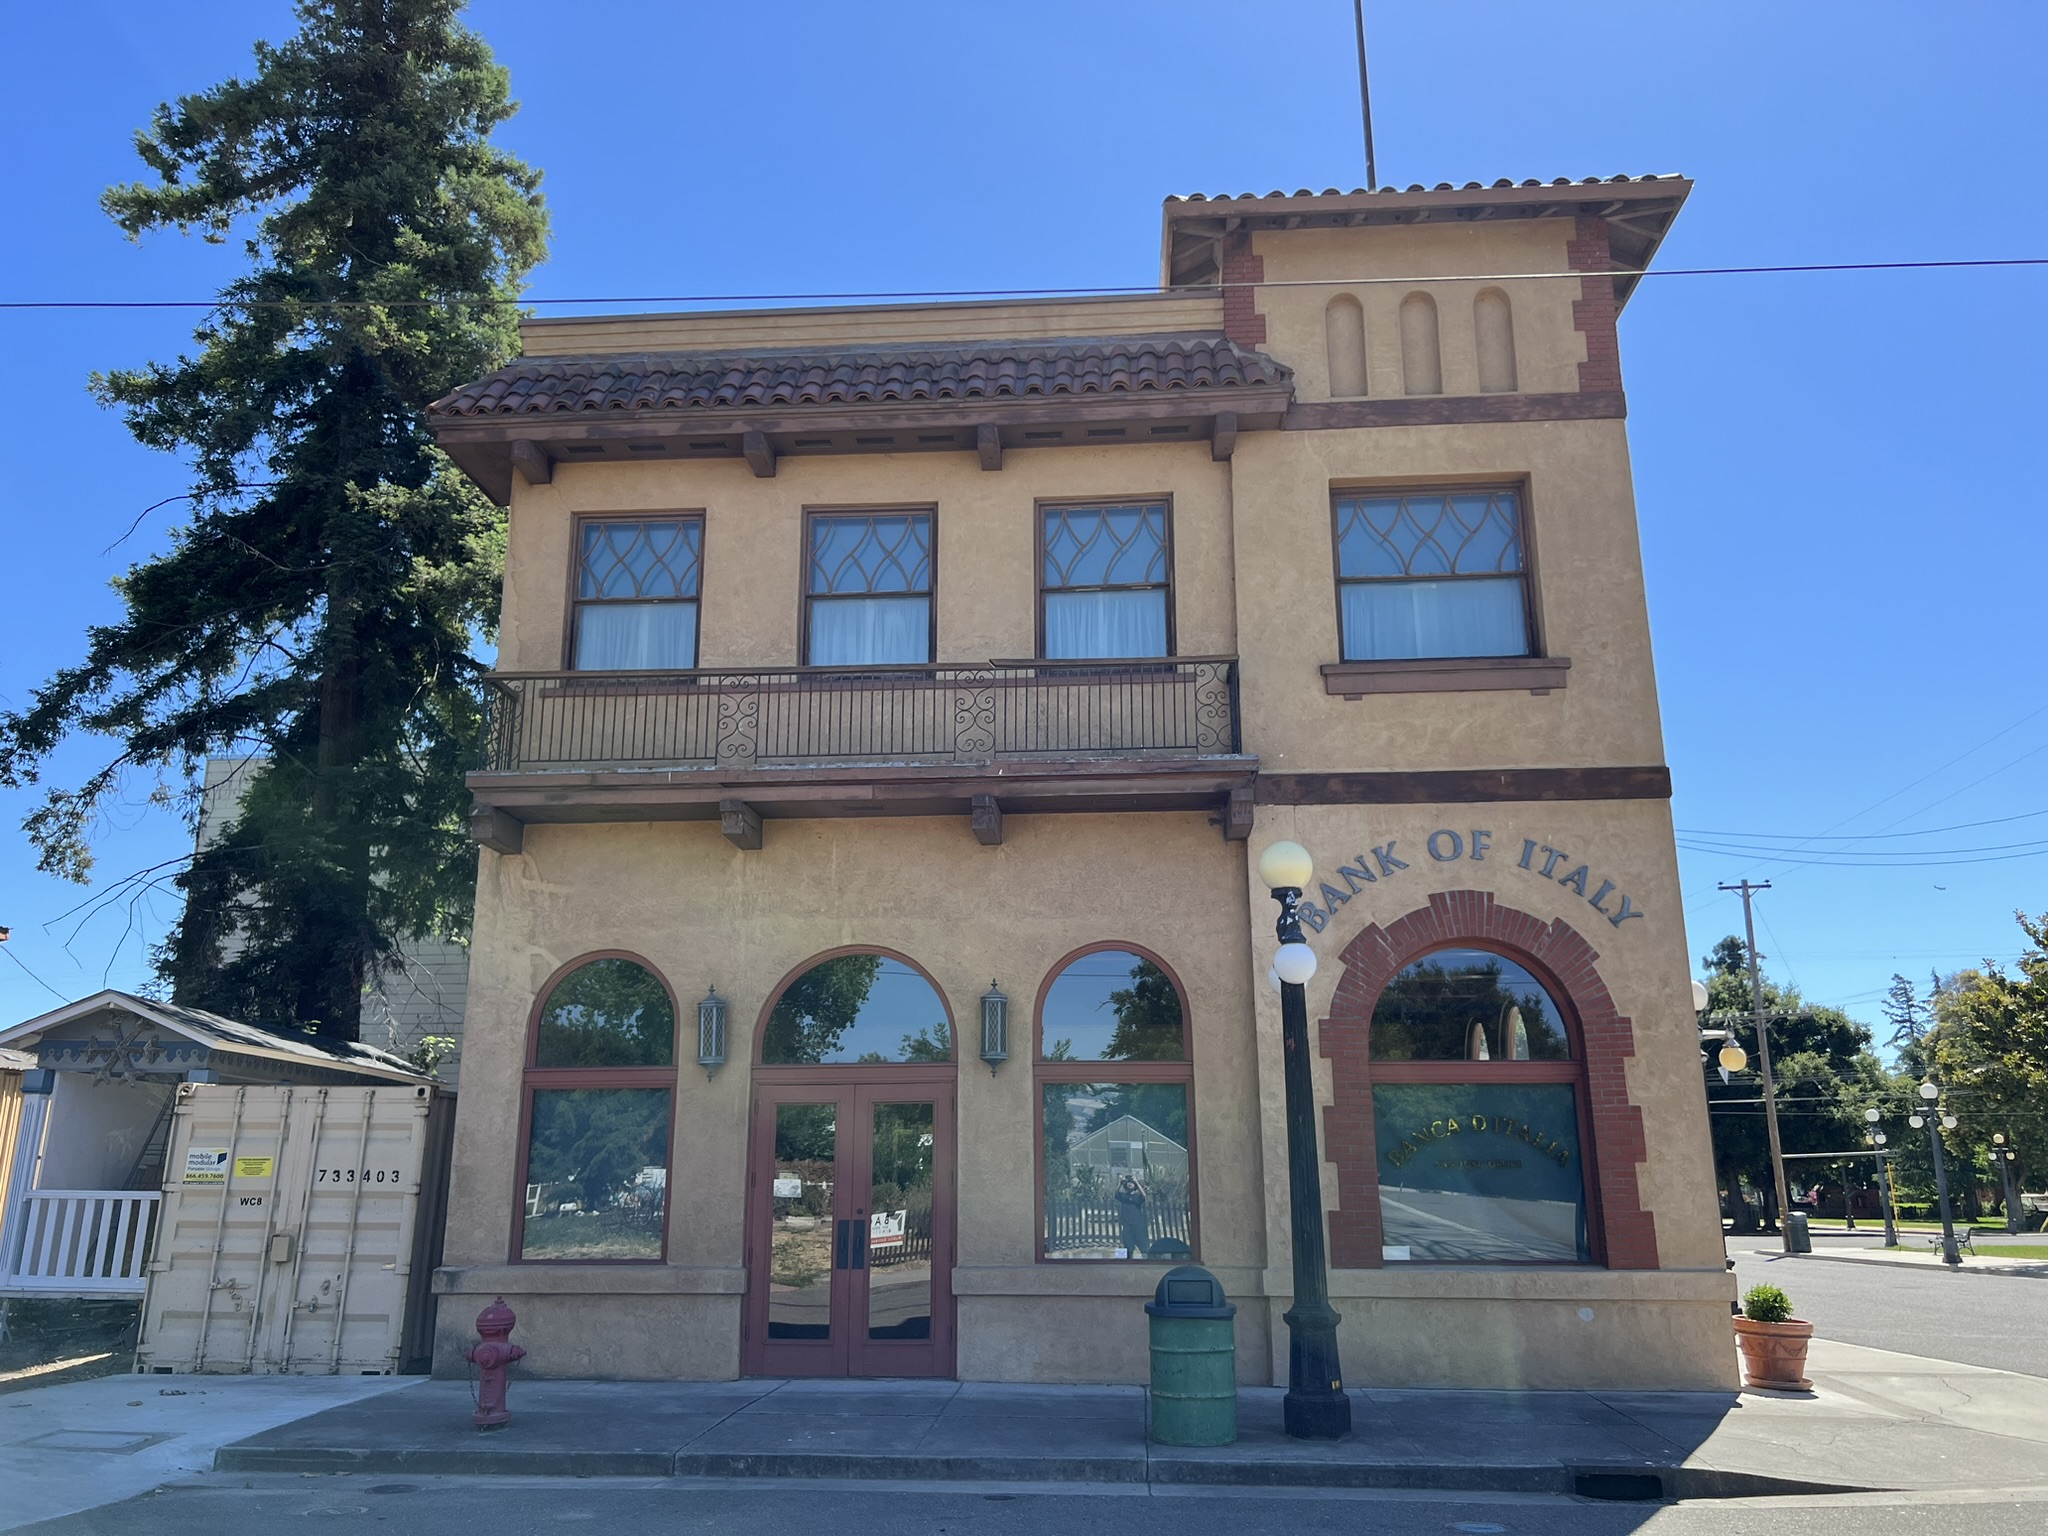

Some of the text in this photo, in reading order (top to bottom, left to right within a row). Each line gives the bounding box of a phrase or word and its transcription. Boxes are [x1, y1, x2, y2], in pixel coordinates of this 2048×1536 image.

[1299, 829, 1644, 933] BANK OF ITALY
[1387, 1118, 1461, 1167] BANCA
[240, 1197, 262, 1206] WC8
